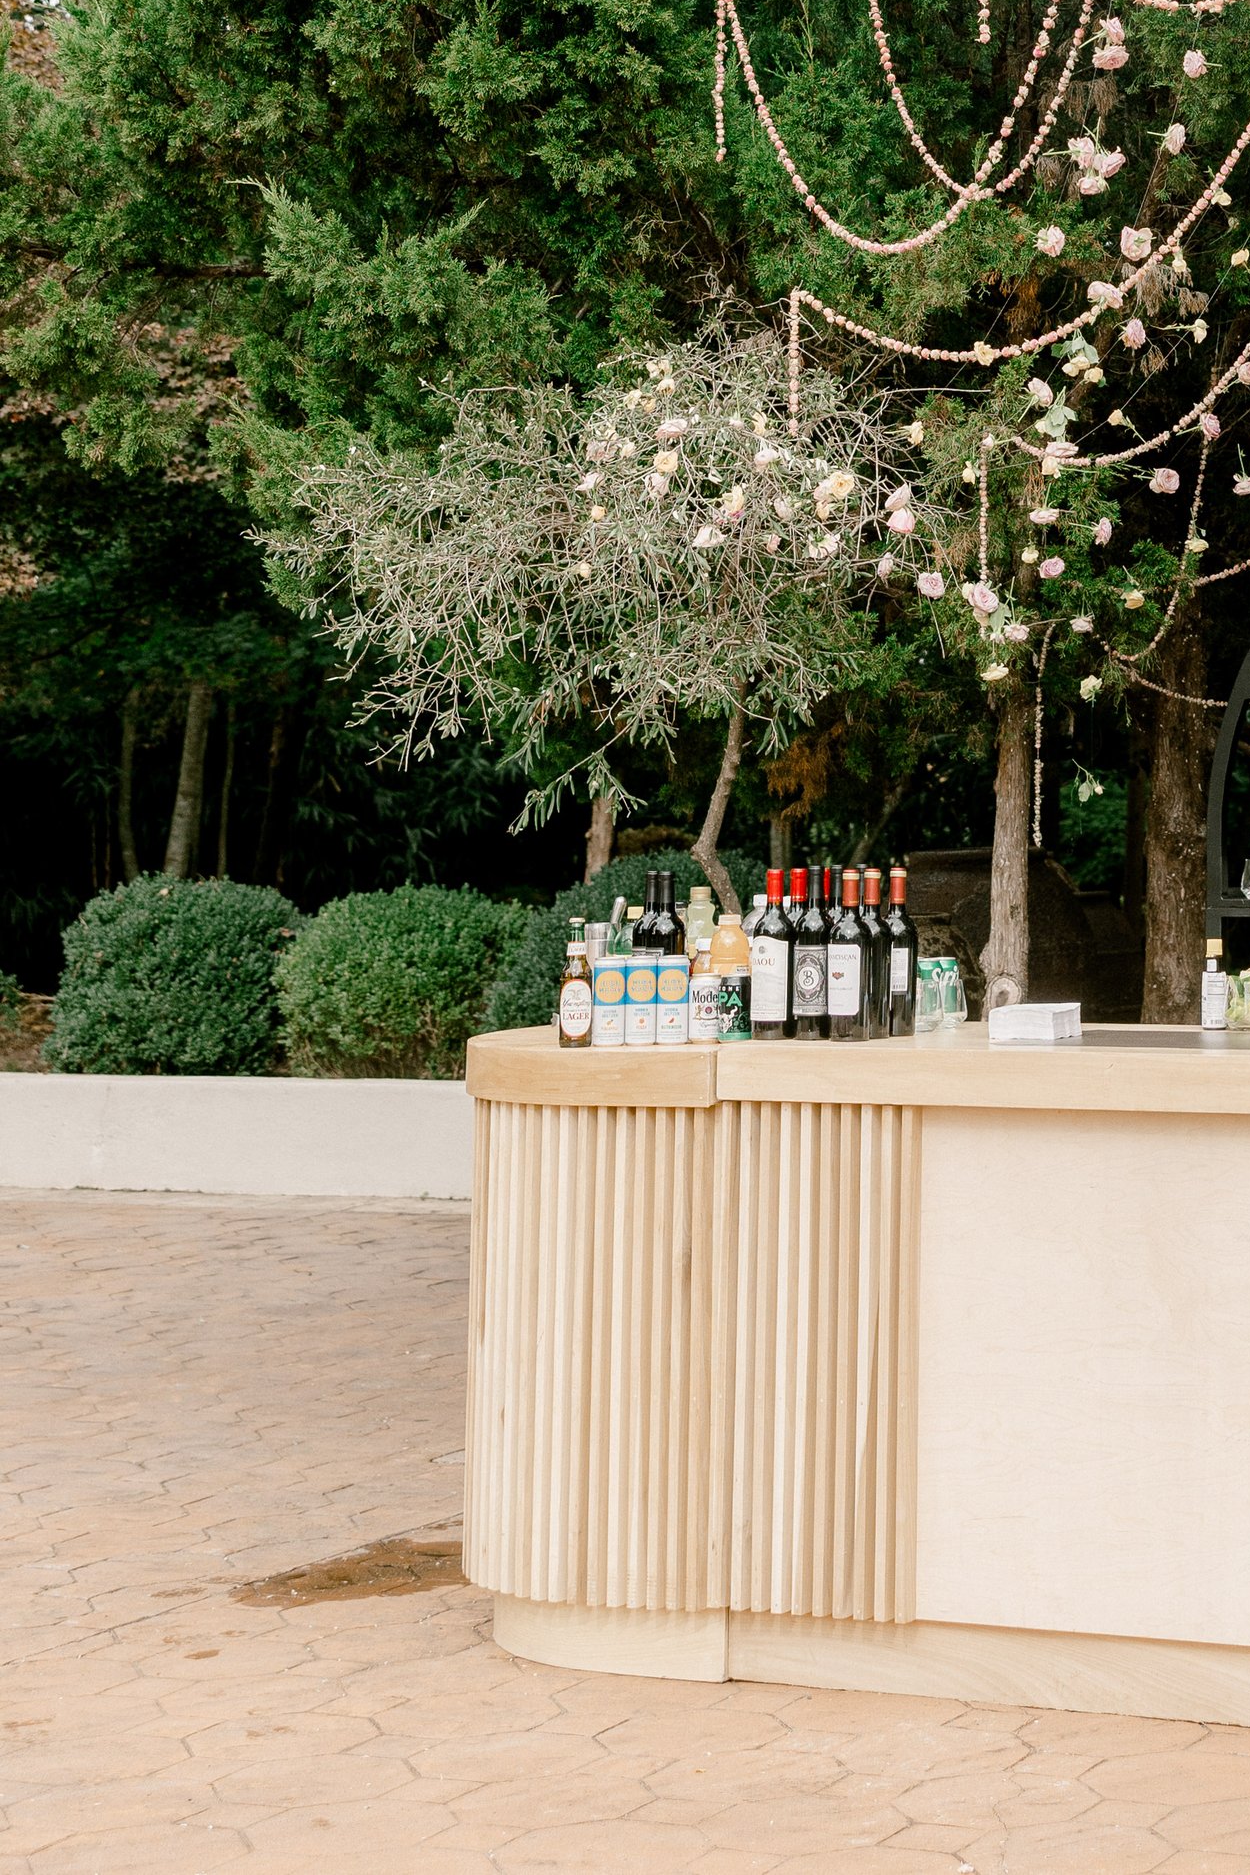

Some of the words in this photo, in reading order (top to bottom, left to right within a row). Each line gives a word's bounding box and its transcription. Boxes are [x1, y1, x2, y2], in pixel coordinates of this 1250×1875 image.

[692, 990, 718, 1003] Mode
[718, 991, 743, 1007] PA
[562, 1012, 590, 1021] LAGER
